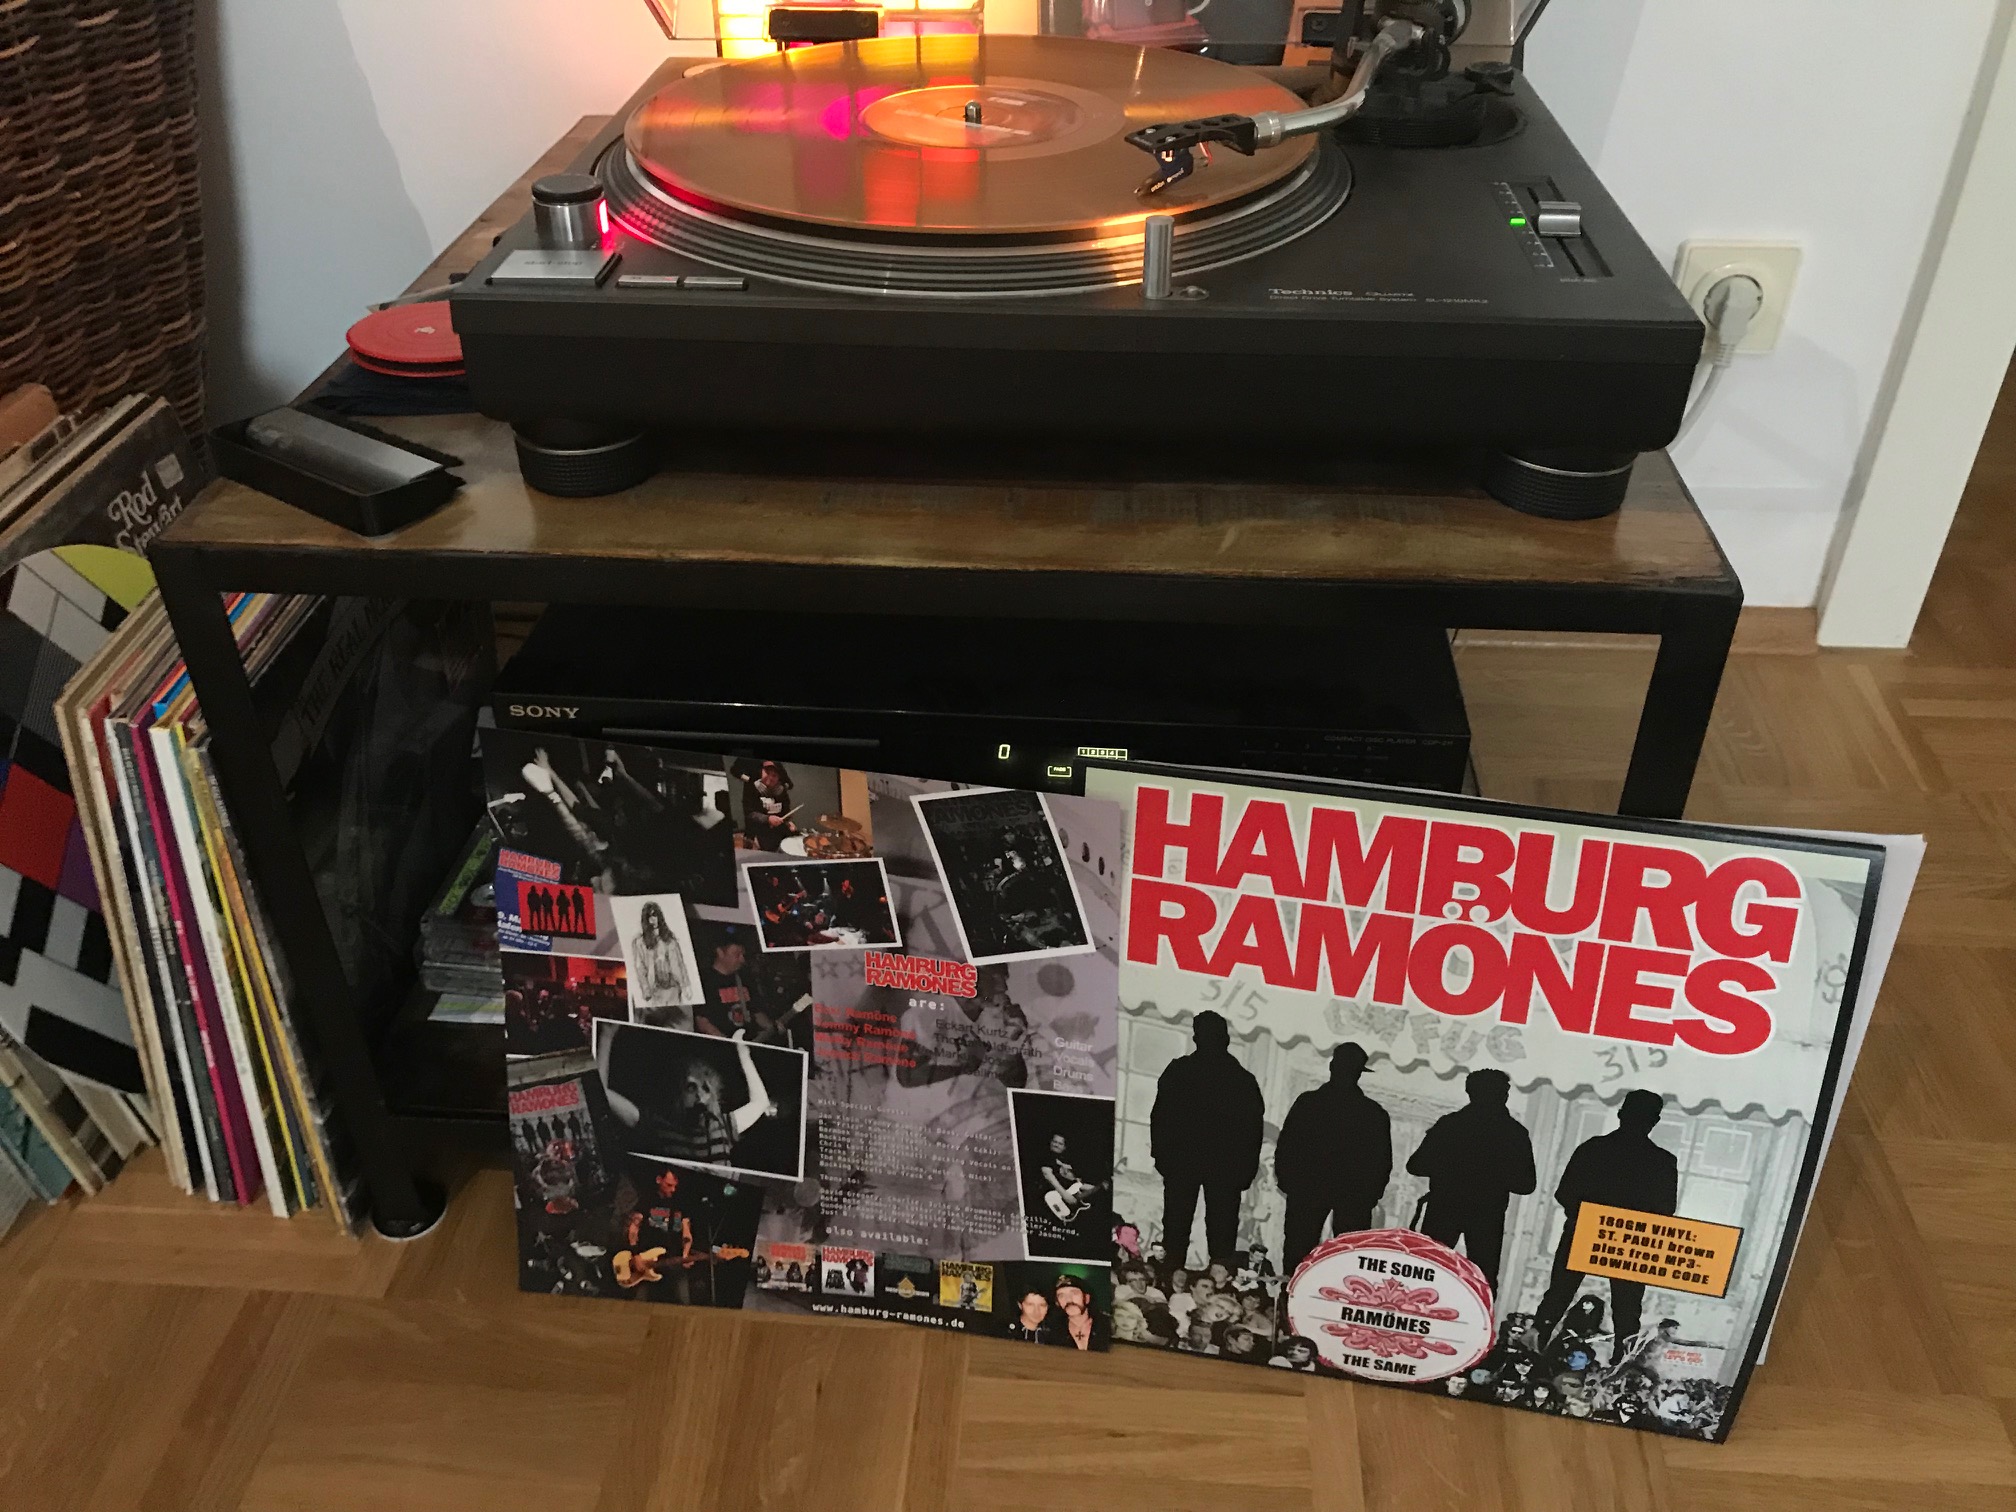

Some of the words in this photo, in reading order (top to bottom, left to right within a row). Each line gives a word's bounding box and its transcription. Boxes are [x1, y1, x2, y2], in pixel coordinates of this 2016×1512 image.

[1269, 288, 1353, 296] Technics
[108, 470, 159, 530] Rod
[509, 705, 580, 719] SONY
[1132, 786, 1803, 962] HAMBURG
[865, 951, 977, 981] HAMBURG
[909, 998, 944, 1011] are:
[1054, 1037, 1094, 1052] Guitar
[1053, 1051, 1095, 1068] Vocals
[1052, 1065, 1095, 1081] Drums
[826, 1226, 854, 1237] also
[860, 1231, 929, 1247] available:
[1651, 1224, 1698, 1242] VINYL:
[1592, 1243, 1625, 1258] plus
[1629, 1248, 1660, 1263] free
[1597, 1229, 1617, 1242] ST.
[1623, 1233, 1664, 1250] PAULI
[1667, 1242, 1715, 1260] brown
[1358, 1256, 1388, 1274] THE
[1390, 1262, 1436, 1282] SONG
[1589, 1255, 1668, 1278] DOWNLOAD
[1672, 1269, 1710, 1286] CODE
[812, 1303, 965, 1329] www.hamburg-ramones.de
[1340, 1306, 1431, 1335] RAMÖNES
[1342, 1353, 1371, 1369] THE
[1373, 1358, 1417, 1376] SAME
